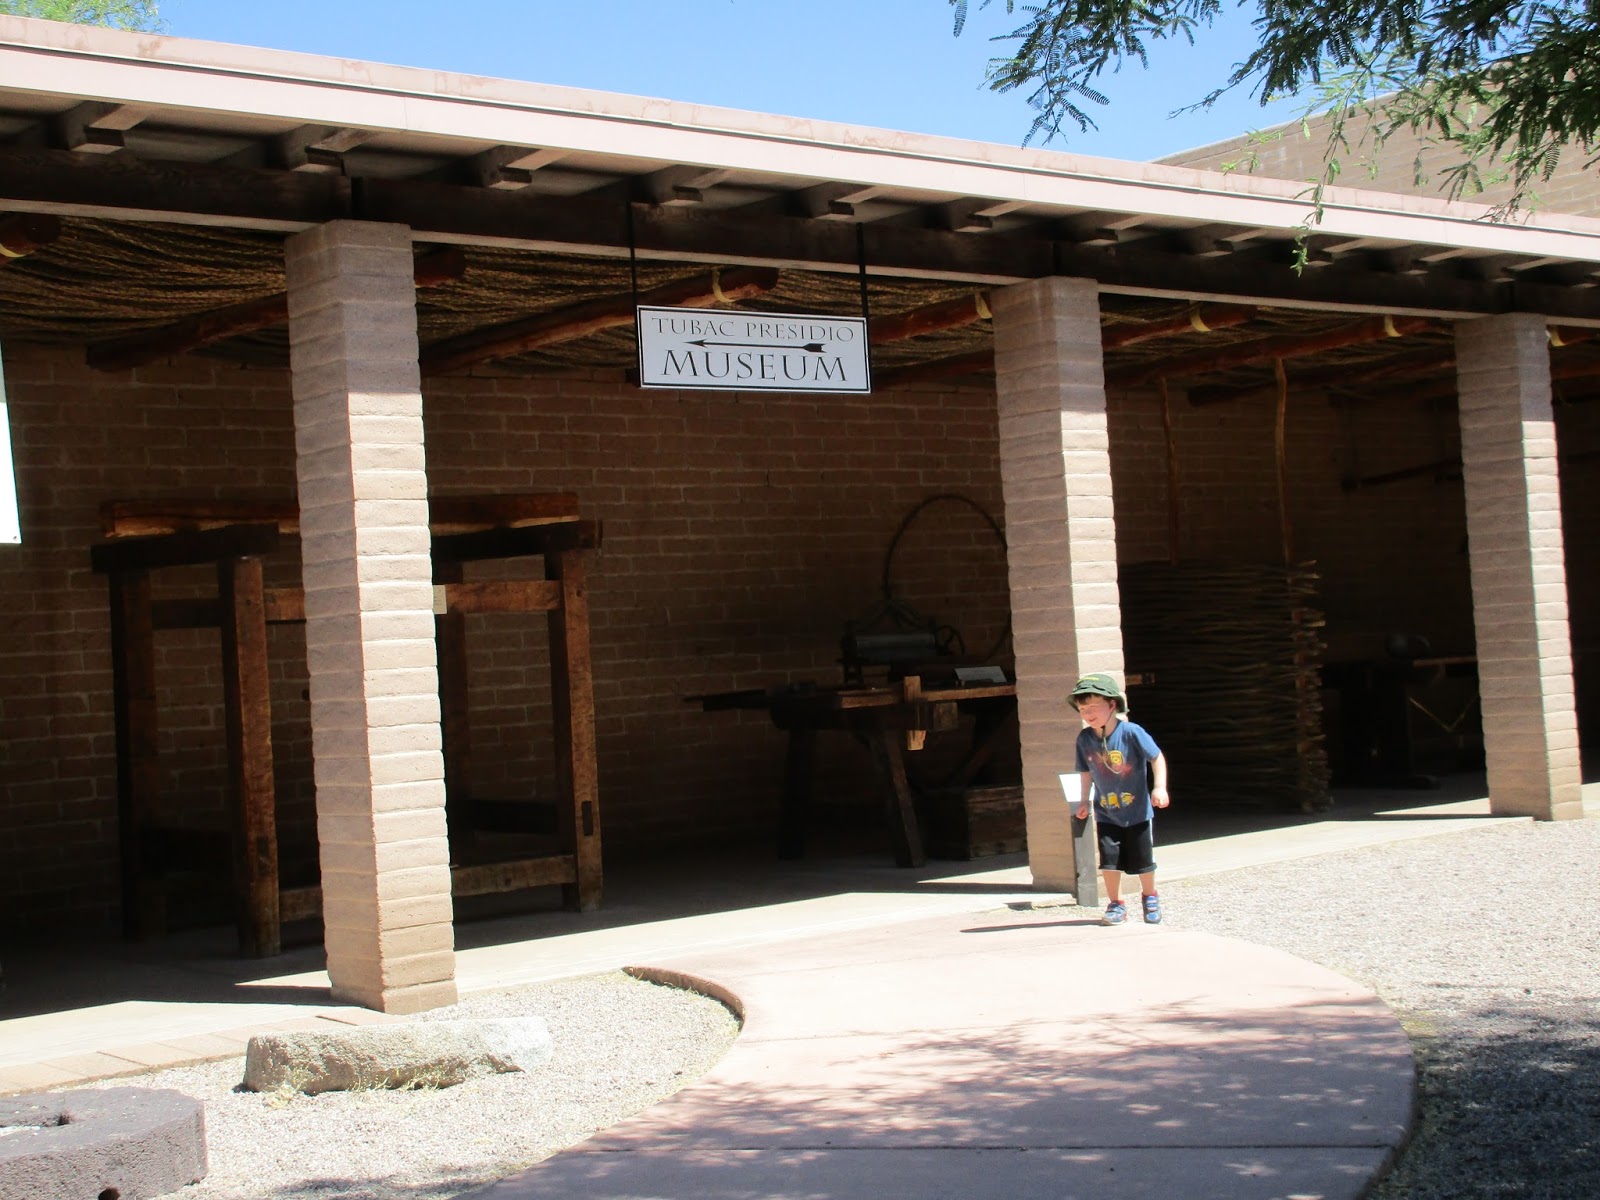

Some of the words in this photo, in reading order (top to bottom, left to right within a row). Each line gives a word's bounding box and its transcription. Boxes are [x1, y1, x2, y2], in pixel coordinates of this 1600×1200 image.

[652, 317, 735, 337] TUBAC
[746, 322, 854, 342] PRESIDIO
[660, 350, 848, 382] MUSEUM
